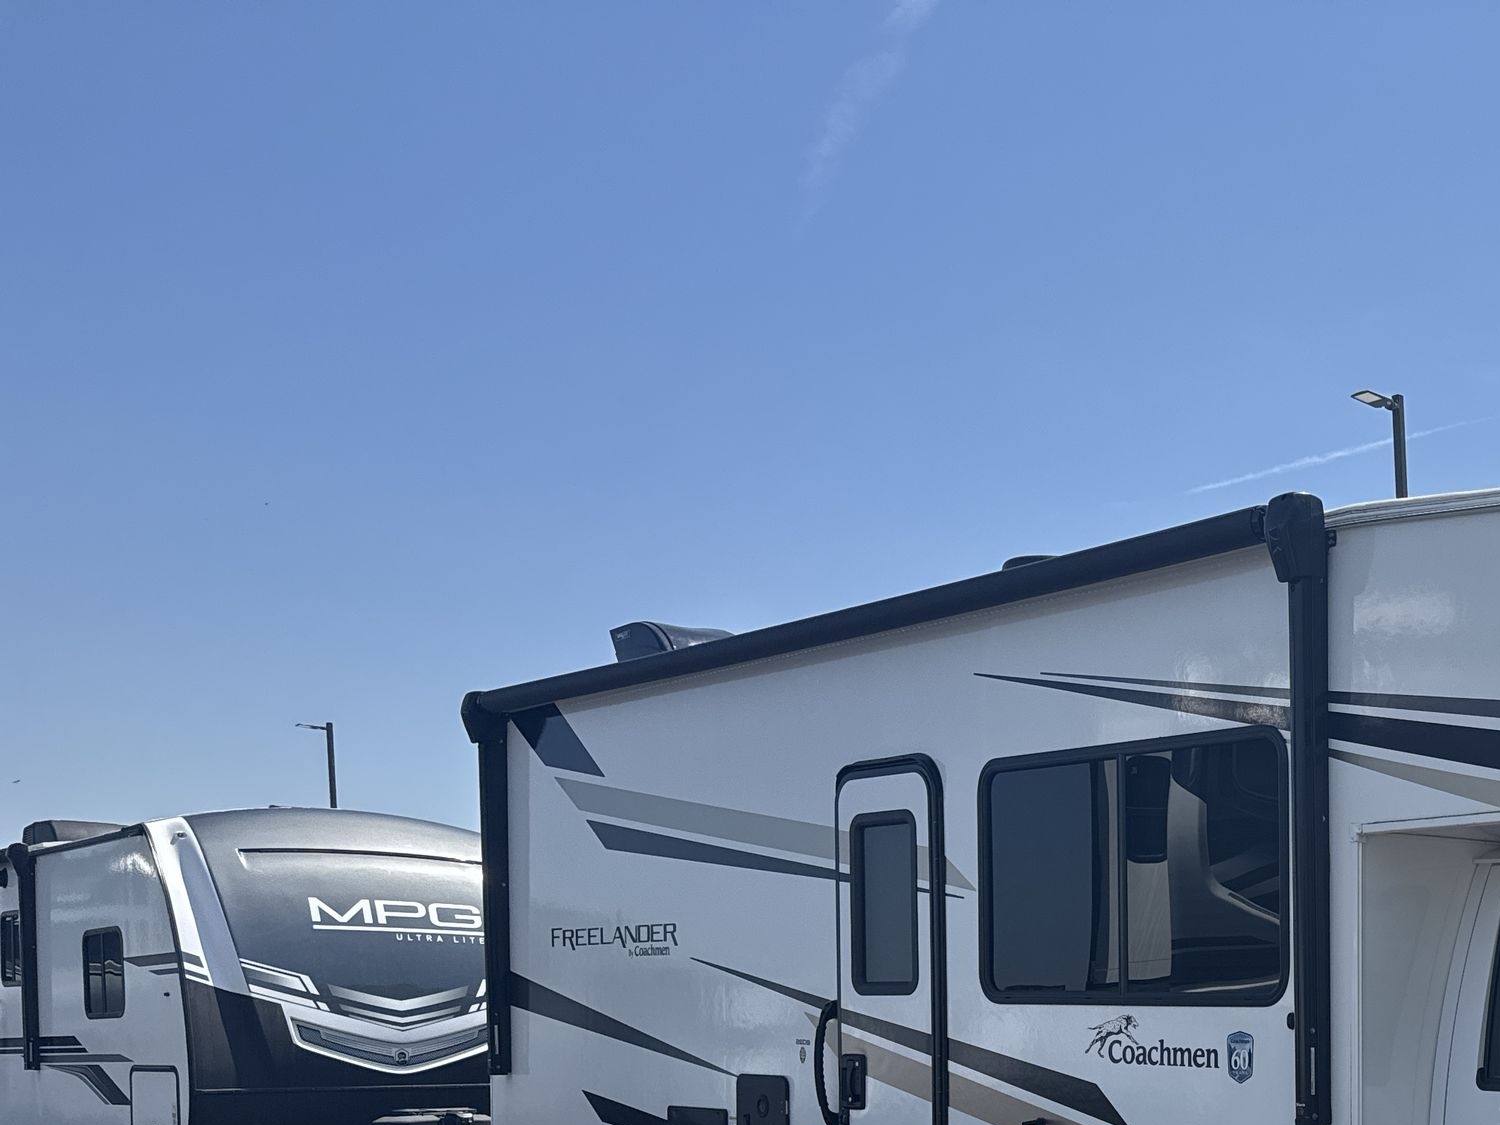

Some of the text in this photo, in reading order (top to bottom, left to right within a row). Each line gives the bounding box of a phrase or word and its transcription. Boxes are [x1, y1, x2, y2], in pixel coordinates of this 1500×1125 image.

[307, 896, 483, 929] MPG
[395, 933, 486, 945] ULTRA LITE
[551, 922, 679, 951] FREELANDER
[634, 944, 671, 957] Coachmen
[1108, 1038, 1220, 1069] Coachmen
[1231, 1049, 1250, 1071] 60
